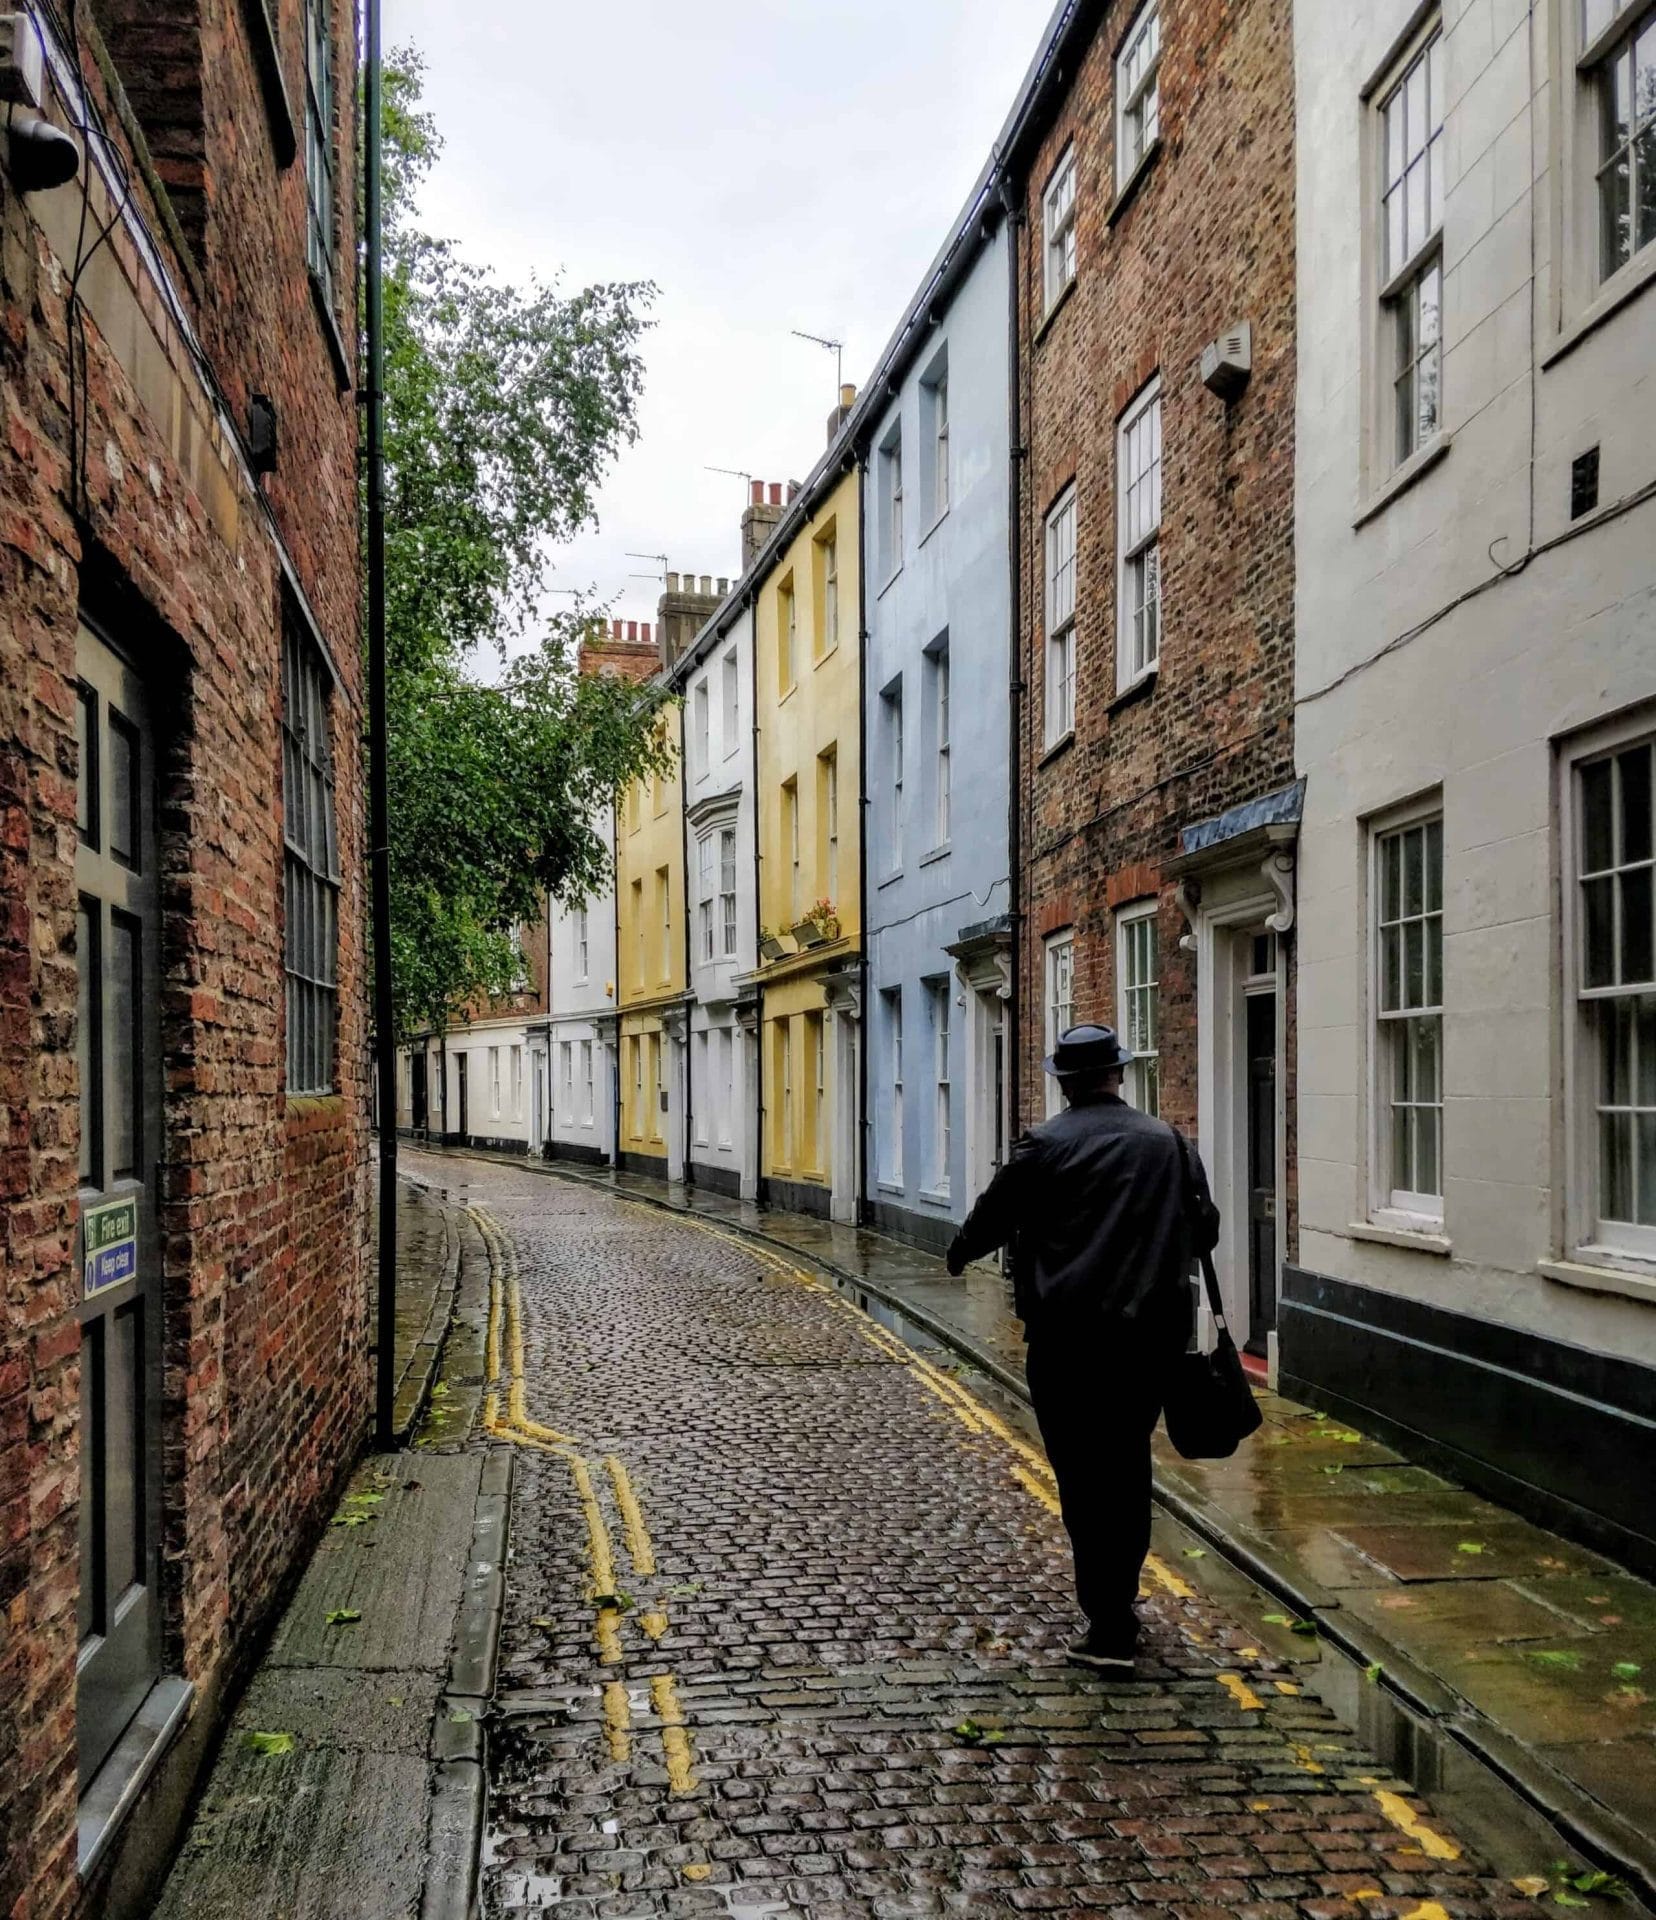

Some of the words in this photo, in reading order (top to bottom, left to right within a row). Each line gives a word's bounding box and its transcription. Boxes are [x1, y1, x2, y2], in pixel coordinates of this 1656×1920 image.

[102, 1215, 115, 1241] Fire
[116, 1210, 129, 1236] exit
[102, 1255, 115, 1277] Keep
